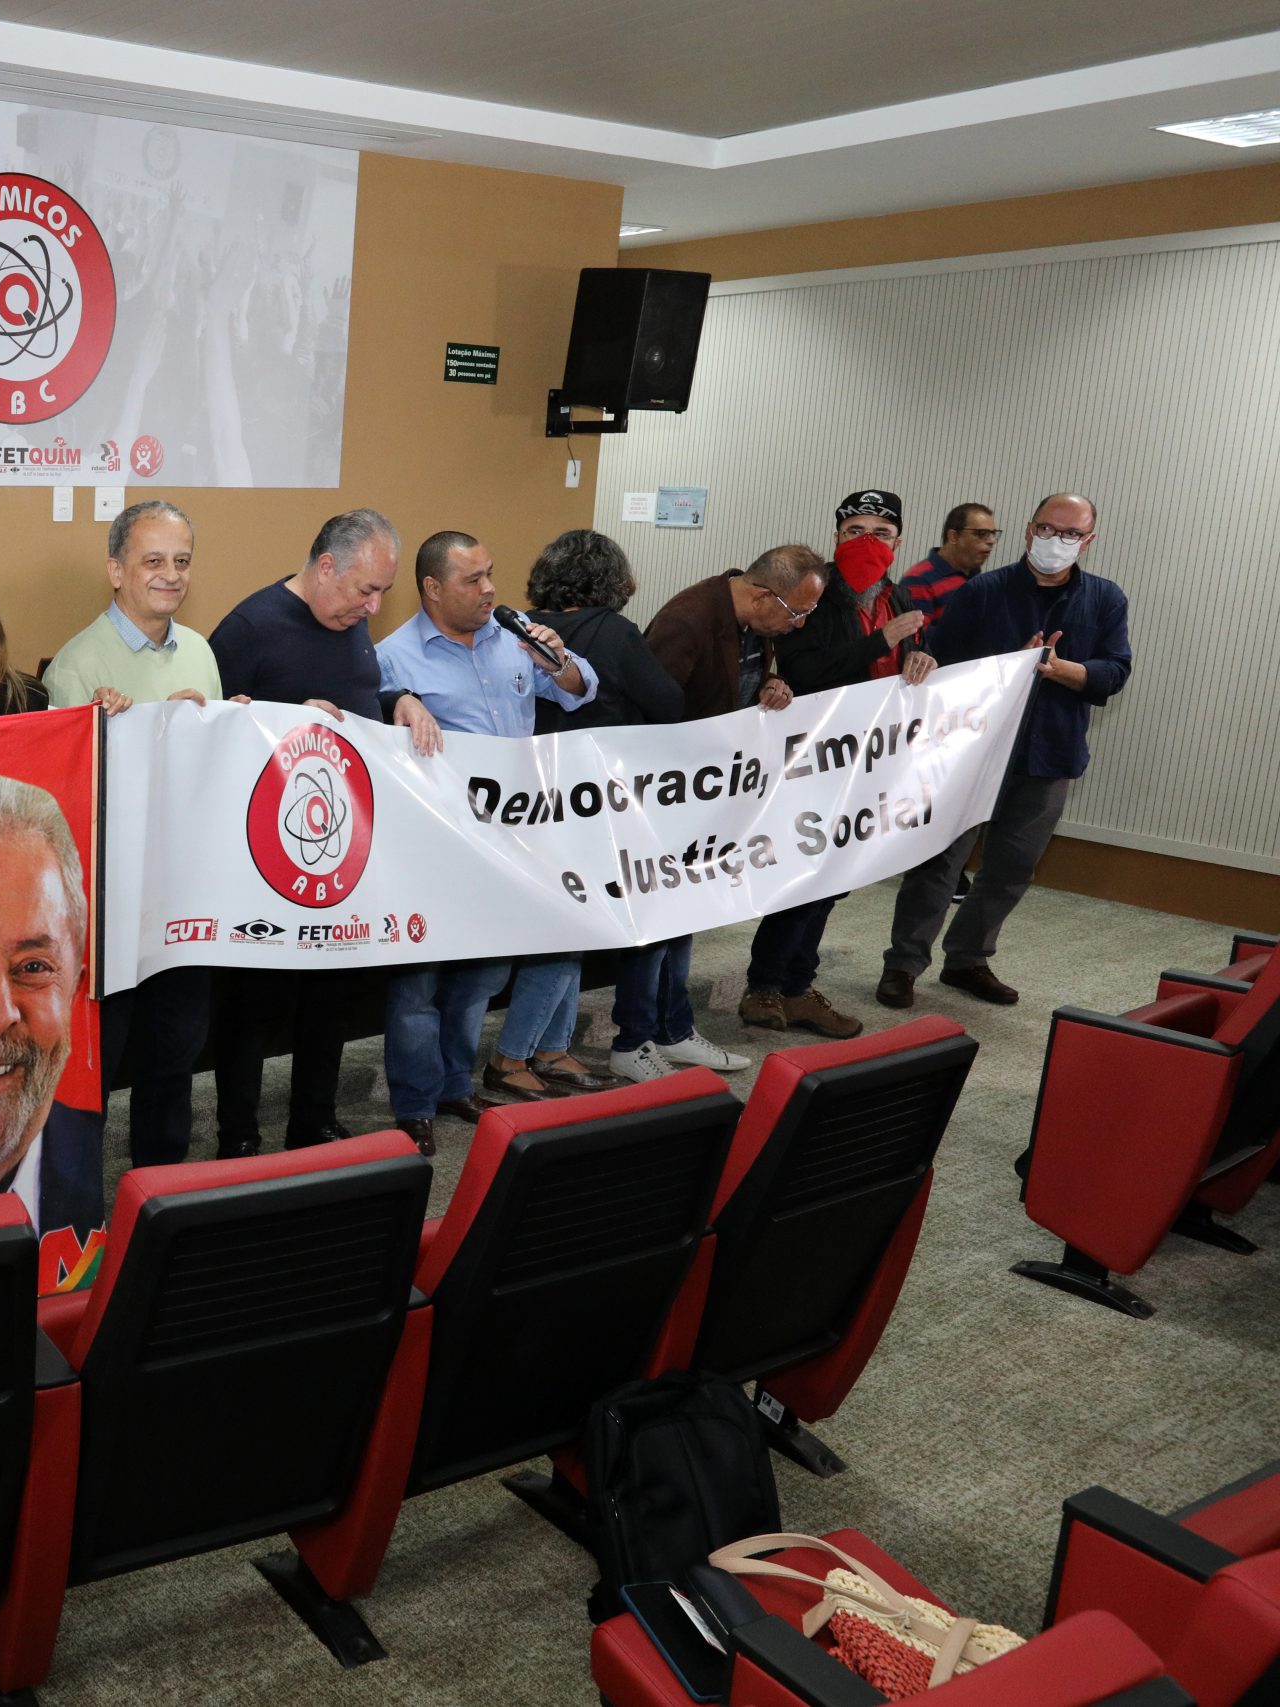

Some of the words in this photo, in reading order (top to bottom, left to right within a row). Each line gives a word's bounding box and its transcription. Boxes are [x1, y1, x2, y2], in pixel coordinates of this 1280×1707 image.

[448, 347, 472, 358] Lotação
[472, 349, 498, 359] Máxima:
[448, 368, 457, 377] 30
[838, 503, 898, 519] MST
[467, 750, 770, 827] Democracia,
[561, 867, 587, 905] e
[604, 831, 777, 899] Justiça
[794, 783, 933, 857] Social
[165, 919, 212, 944] CUT
